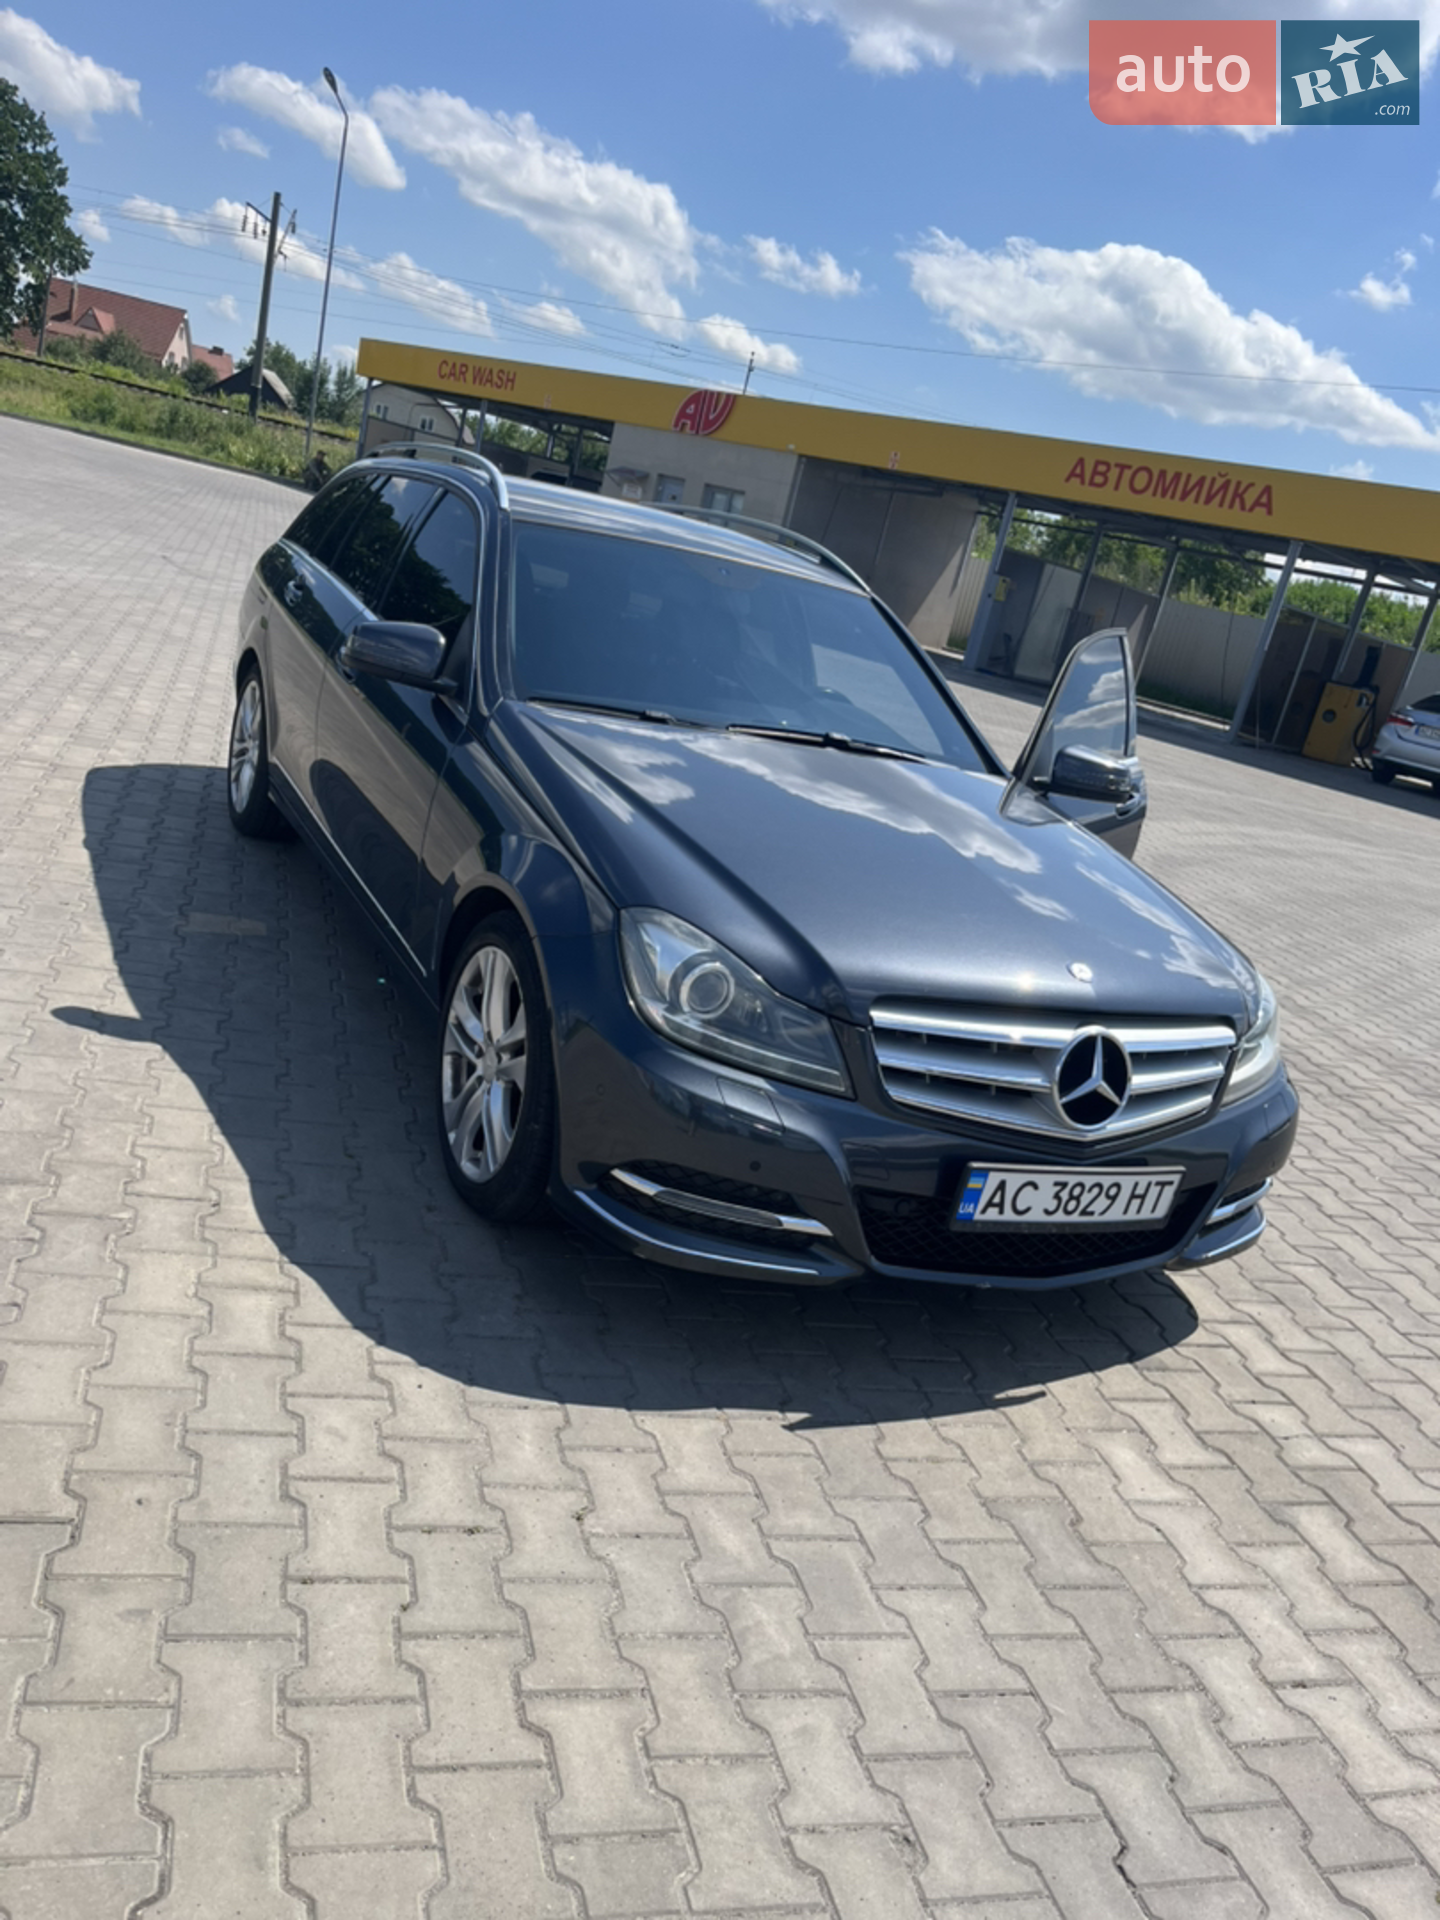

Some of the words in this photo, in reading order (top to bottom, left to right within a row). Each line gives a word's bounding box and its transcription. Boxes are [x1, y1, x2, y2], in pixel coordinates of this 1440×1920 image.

[437, 359, 468, 384] CAR
[472, 364, 517, 391] WASH
[1064, 457, 1273, 516] АВТОМИЙКА
[958, 1202, 975, 1214] UA
[979, 1179, 1039, 1216] AC
[1043, 1181, 1122, 1217] 3829
[1122, 1181, 1175, 1216] HT
